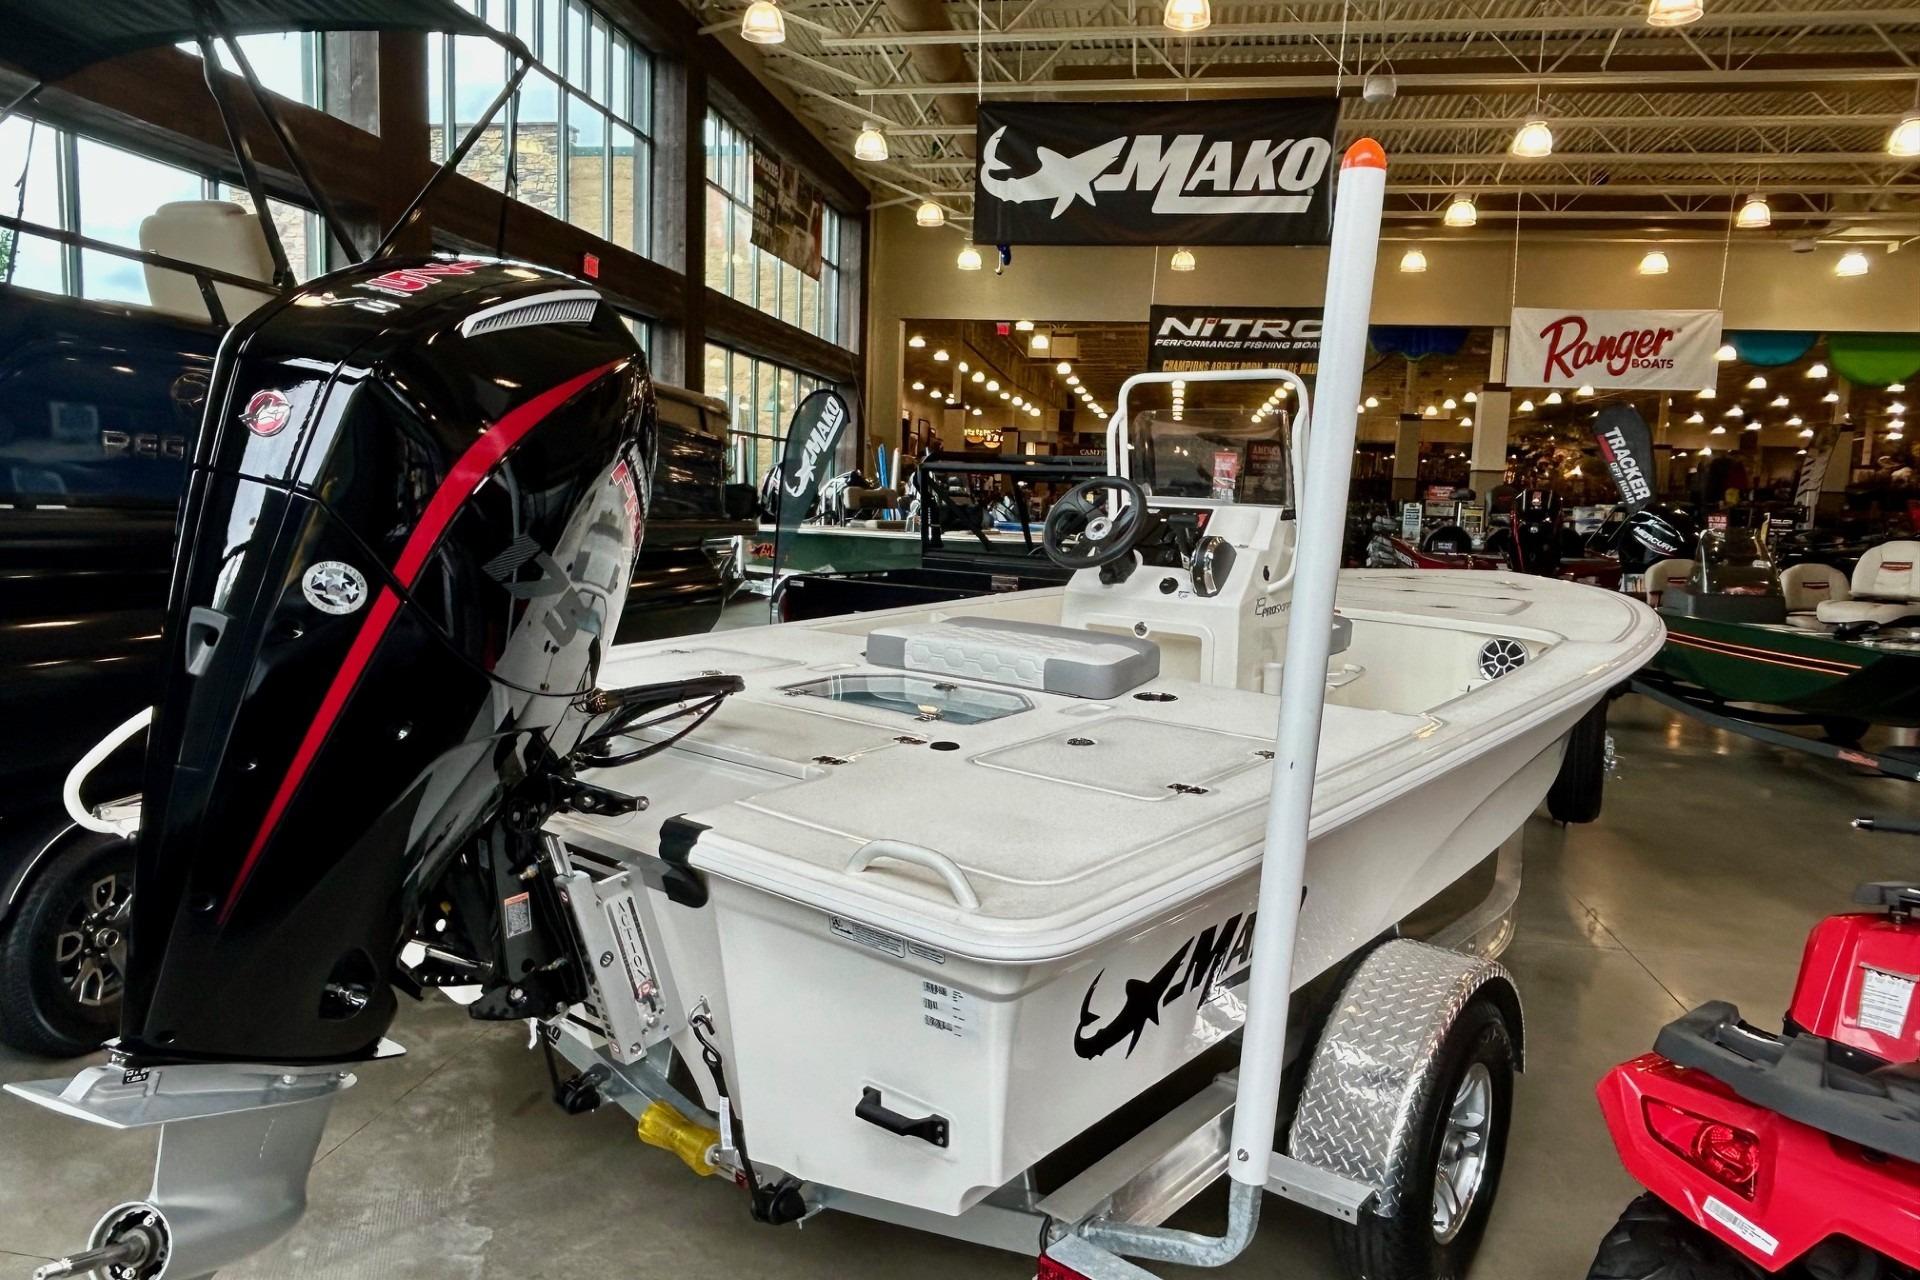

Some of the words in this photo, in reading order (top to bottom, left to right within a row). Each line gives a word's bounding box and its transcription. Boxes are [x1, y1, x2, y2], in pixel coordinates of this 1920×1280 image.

[1095, 134, 1332, 214] MAKO
[1154, 338, 1241, 349] PERFORMANCE
[1243, 341, 1291, 349] FISHING
[1540, 315, 1673, 383] Ranger
[1631, 358, 1674, 369] BOATS
[805, 395, 844, 465] MAKO
[1604, 425, 1651, 501] TRACKER
[1633, 526, 1678, 552] MERCURY
